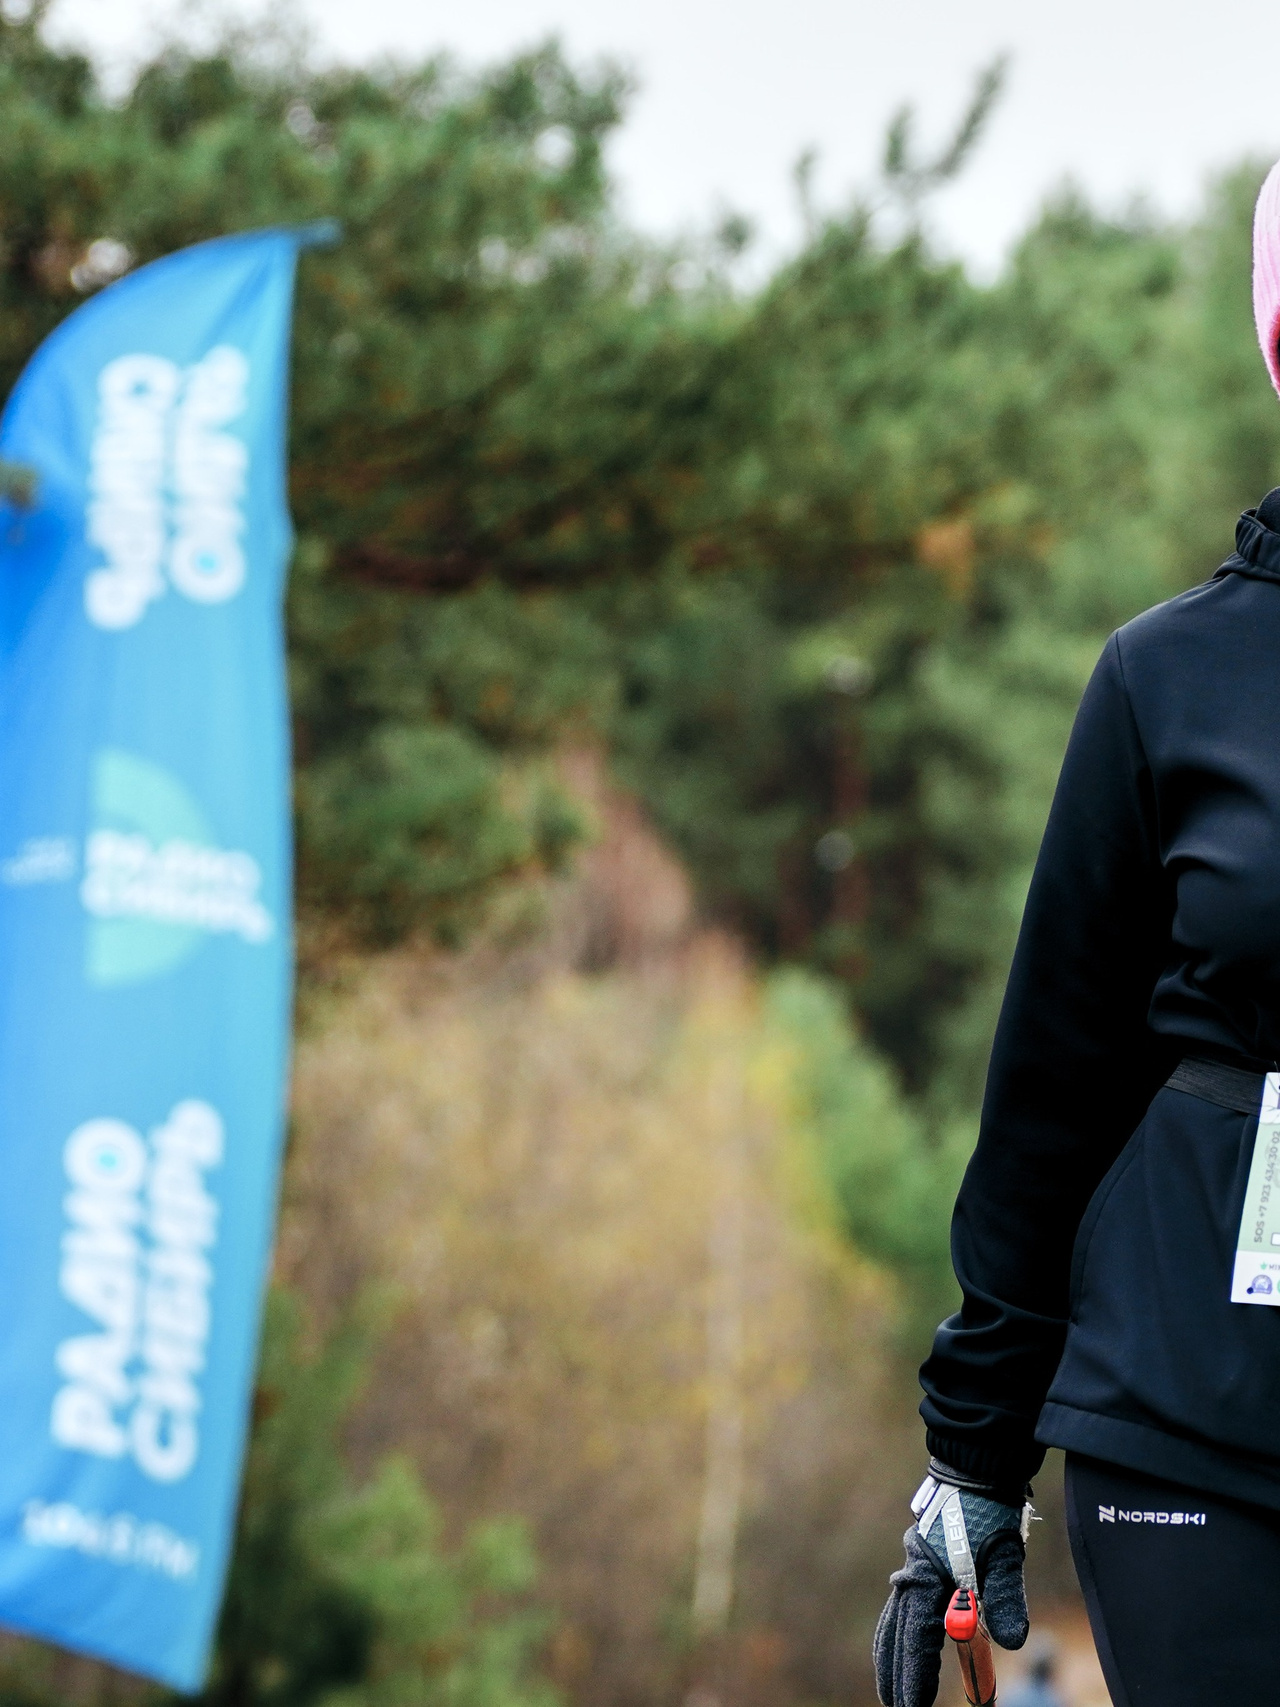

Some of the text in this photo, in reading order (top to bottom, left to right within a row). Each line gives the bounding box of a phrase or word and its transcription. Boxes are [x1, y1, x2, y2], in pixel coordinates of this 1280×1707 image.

[1271, 1130, 1280, 1144] 02
[1268, 1146, 1278, 1160] 30
[1260, 1184, 1271, 1203] 923
[1258, 1205, 1267, 1217] +7
[1253, 1220, 1265, 1243] SOS
[51, 1117, 149, 1458] РАДИО
[1118, 1509, 1206, 1525] NORDSKI
[946, 1507, 967, 1556] LEKI
